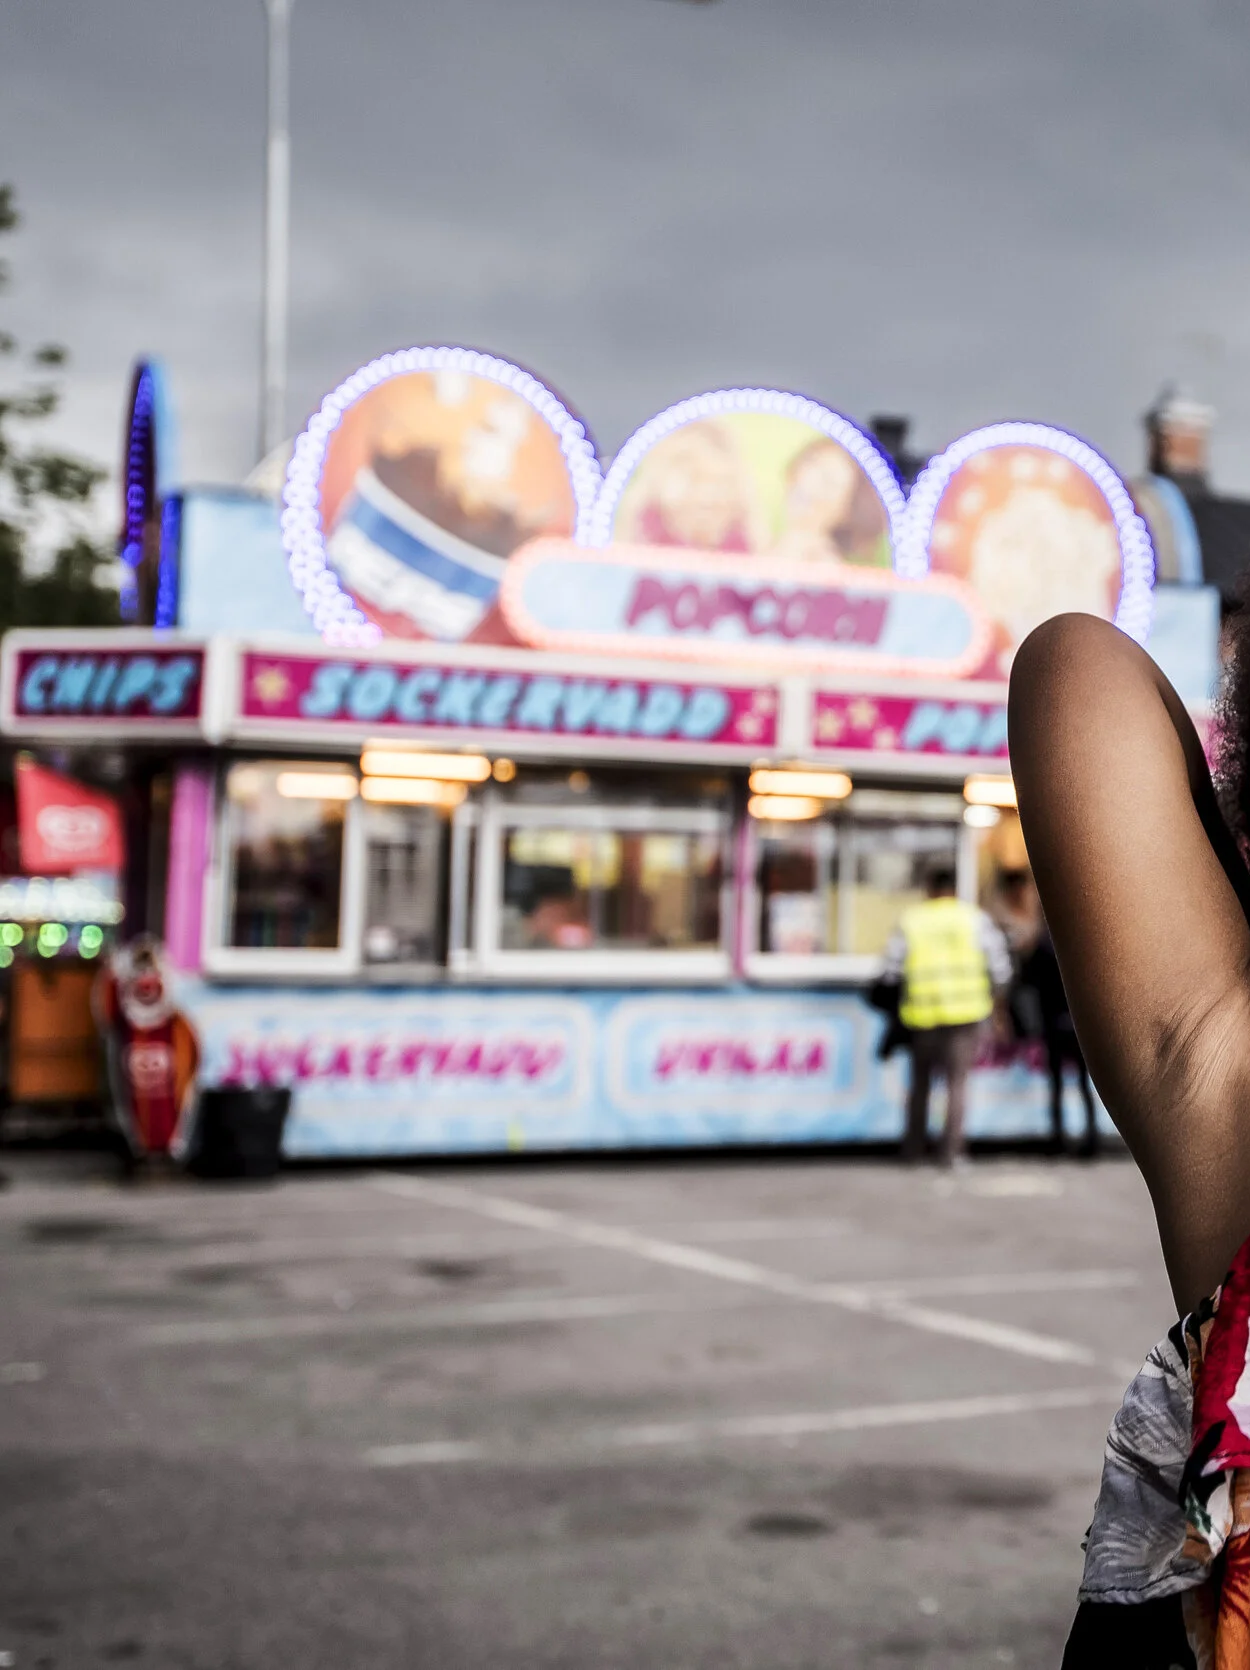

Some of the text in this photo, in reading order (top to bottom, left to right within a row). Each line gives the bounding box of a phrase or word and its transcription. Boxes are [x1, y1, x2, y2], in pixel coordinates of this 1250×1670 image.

[624, 574, 891, 648] POPCORN
[22, 656, 196, 710] CHIPS
[301, 660, 732, 741] SOCKERVADD
